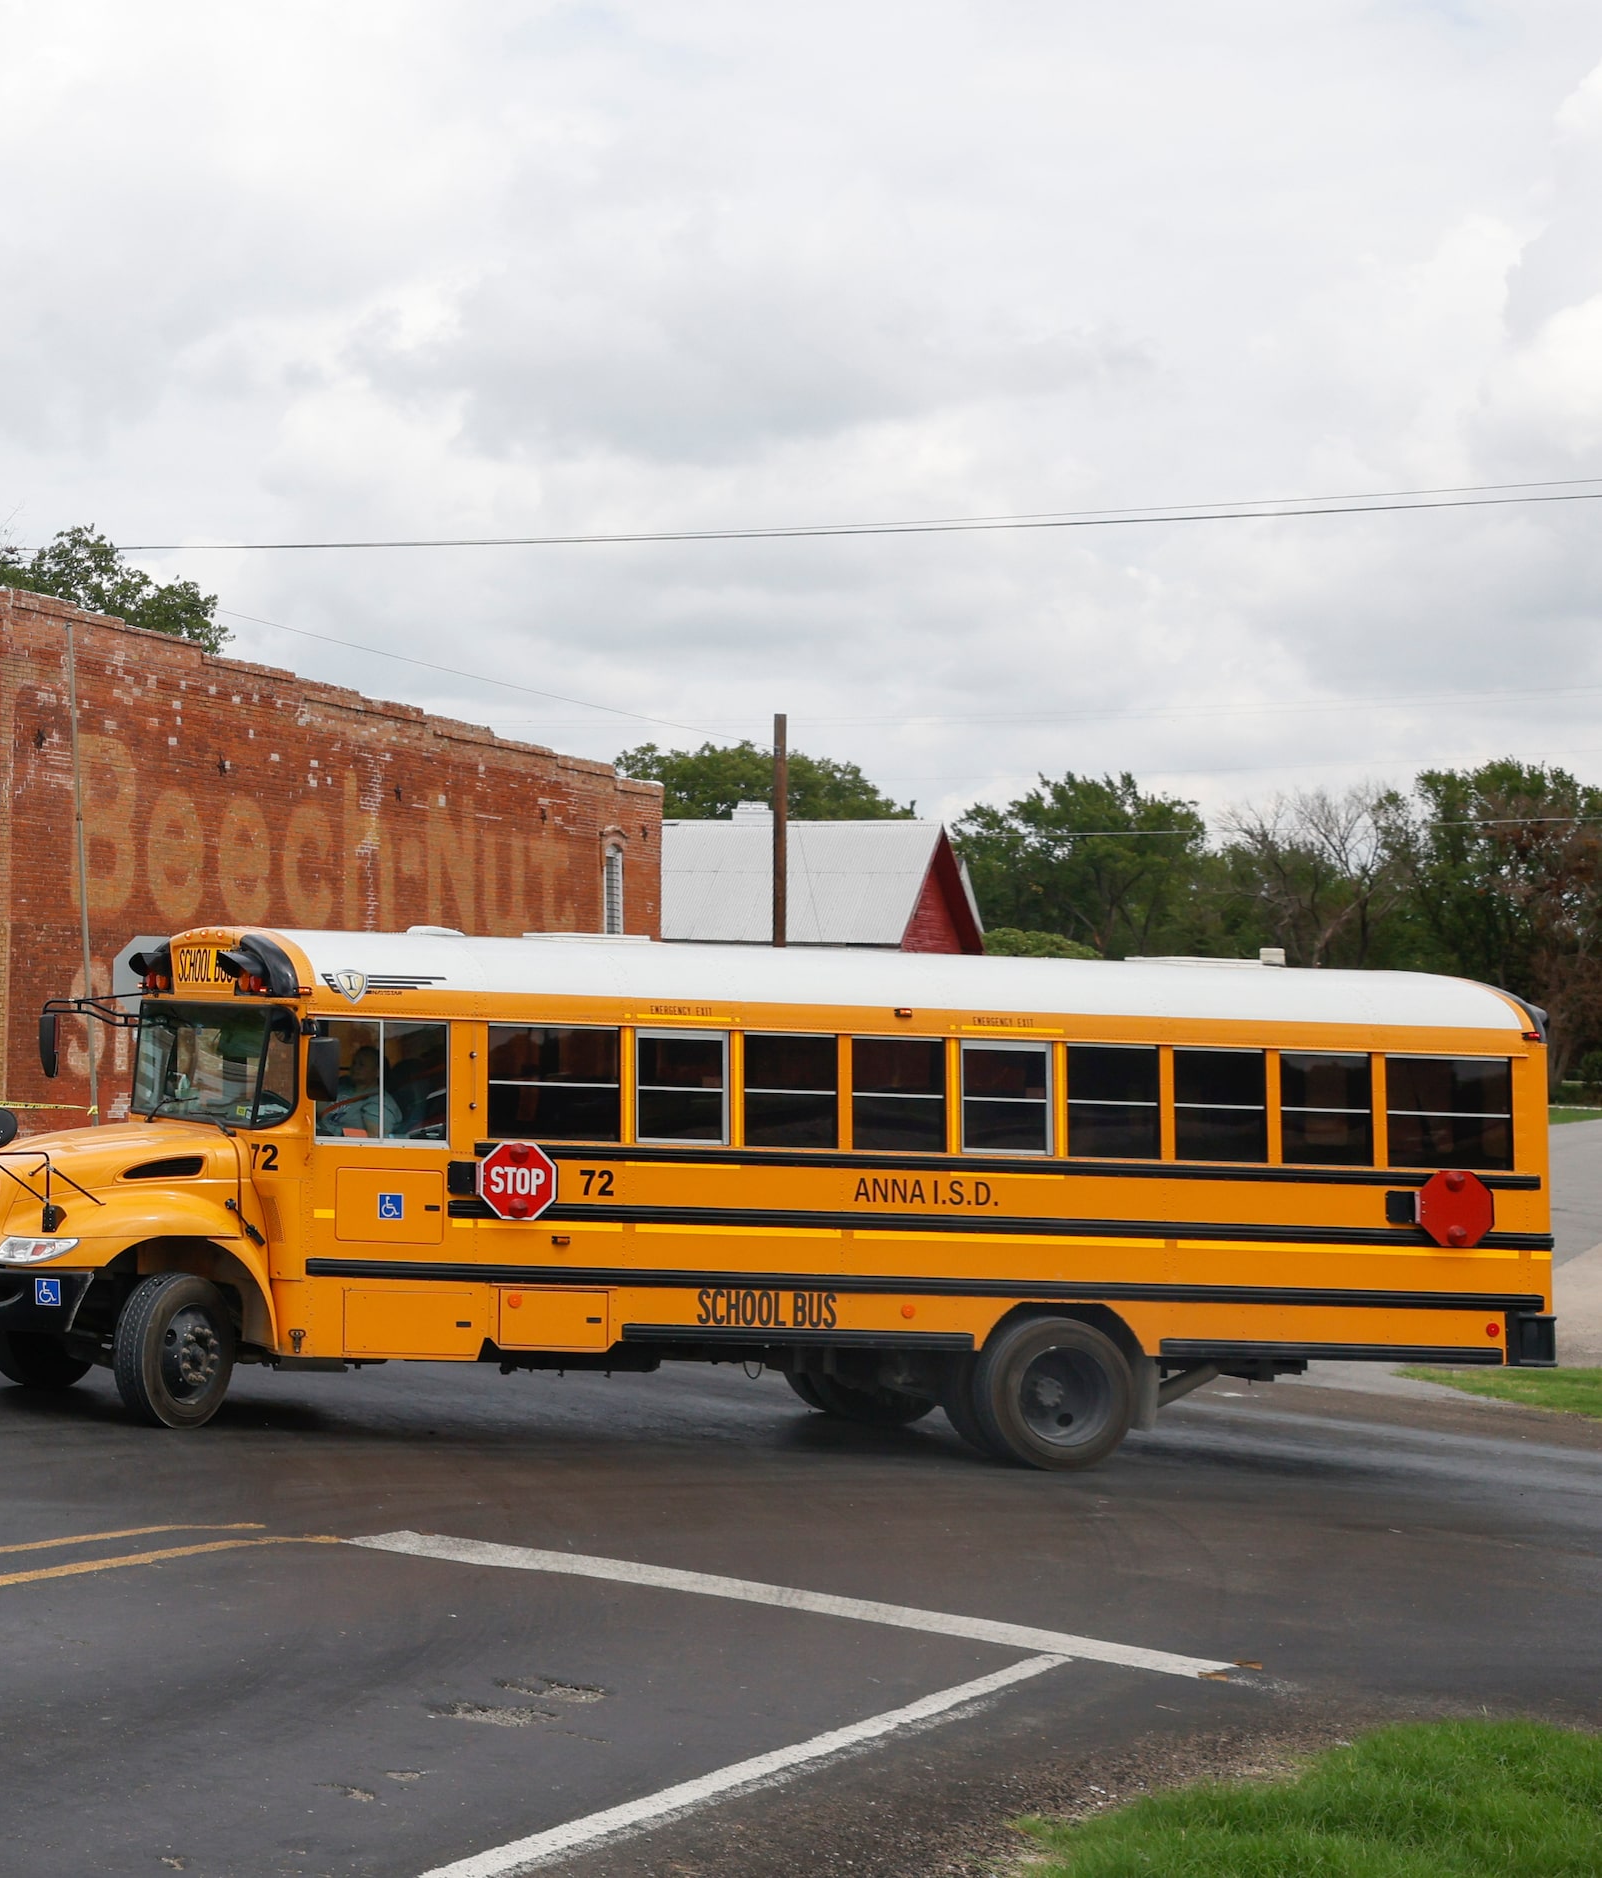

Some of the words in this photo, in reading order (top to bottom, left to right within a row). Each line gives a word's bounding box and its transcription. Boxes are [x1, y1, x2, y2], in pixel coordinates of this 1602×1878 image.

[179, 949, 211, 982] SCHOOL
[650, 1005, 691, 1015] EMERGENCY
[696, 1006, 712, 1016] EXIT
[973, 1016, 1013, 1027] EMERGENCY
[1017, 1018, 1033, 1028] EXIT
[251, 1143, 278, 1171] 72
[490, 1166, 545, 1195] STOP
[580, 1170, 614, 1196] 72
[854, 1177, 926, 1204] ANNA
[934, 1180, 999, 1206] I.S.D.
[697, 1289, 786, 1326] SCHOOL
[793, 1292, 837, 1328] BUS
